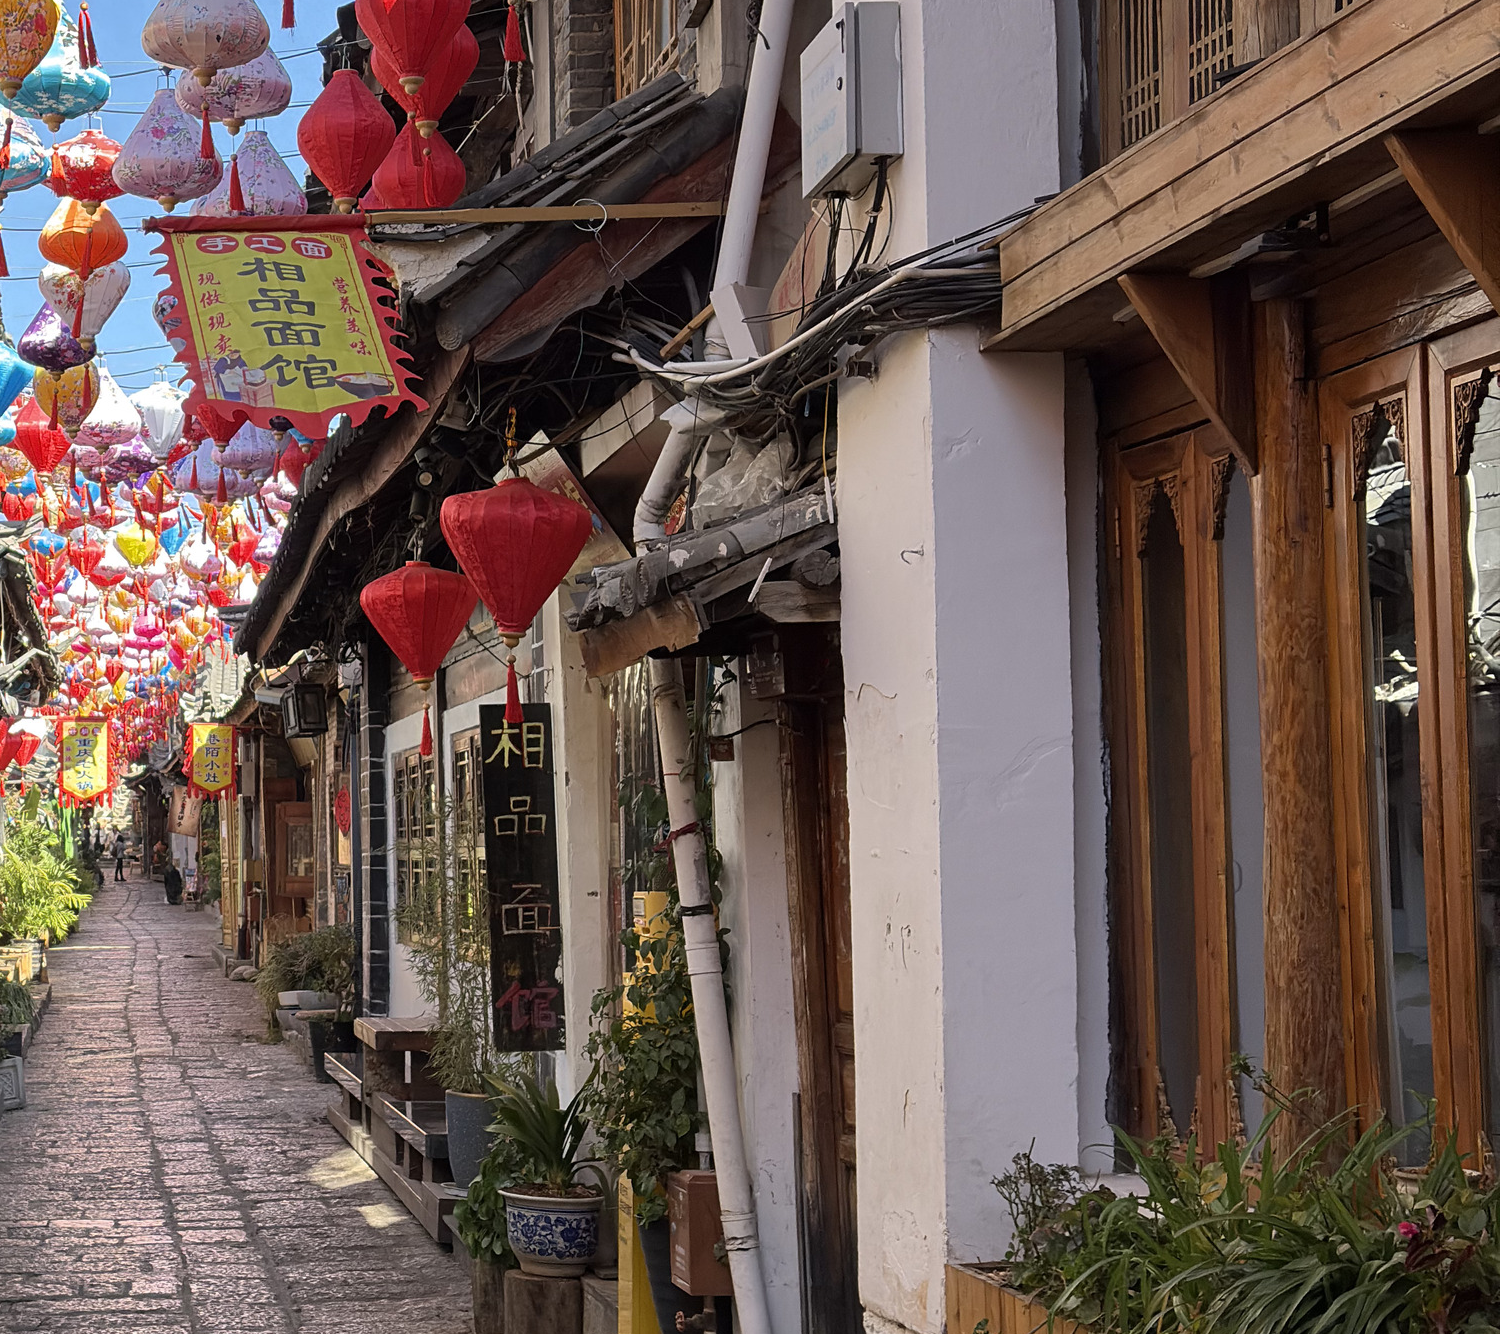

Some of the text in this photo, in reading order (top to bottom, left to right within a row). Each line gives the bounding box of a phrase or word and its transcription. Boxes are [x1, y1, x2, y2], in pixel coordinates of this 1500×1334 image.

[200, 235, 328, 258] 手工面
[197, 271, 234, 357] 现做现卖
[236, 256, 339, 390] 相品面馆
[331, 276, 373, 358] 营养美味
[75, 738, 95, 791] 重庆老火锅
[203, 733, 221, 784] 巷陌小灶
[484, 719, 559, 1030] 相品面馆
